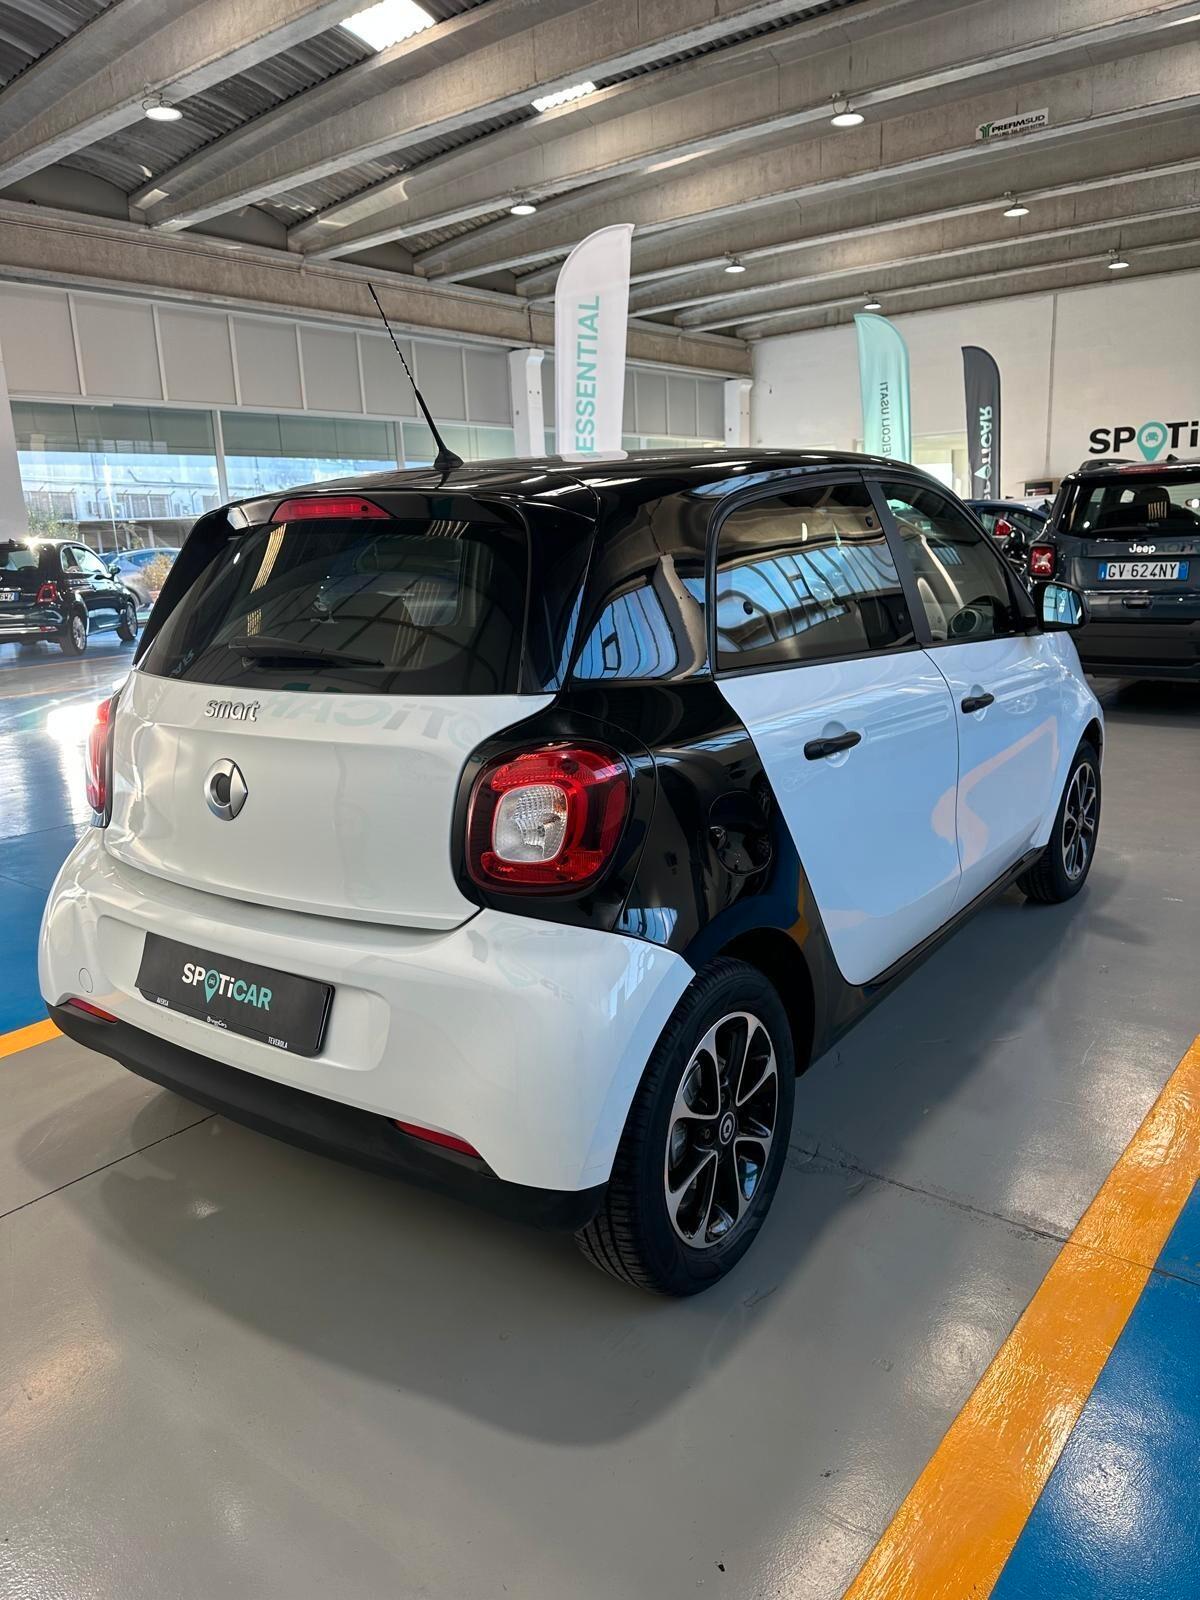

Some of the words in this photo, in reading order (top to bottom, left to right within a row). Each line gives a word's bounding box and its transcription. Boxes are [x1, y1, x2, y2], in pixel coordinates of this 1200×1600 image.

[576, 296, 600, 452] ESSENTIAL
[1129, 543, 1156, 554] Jeep
[1108, 564, 1126, 578] GV
[1130, 563, 1177, 578] 624NY
[204, 700, 260, 722] smart
